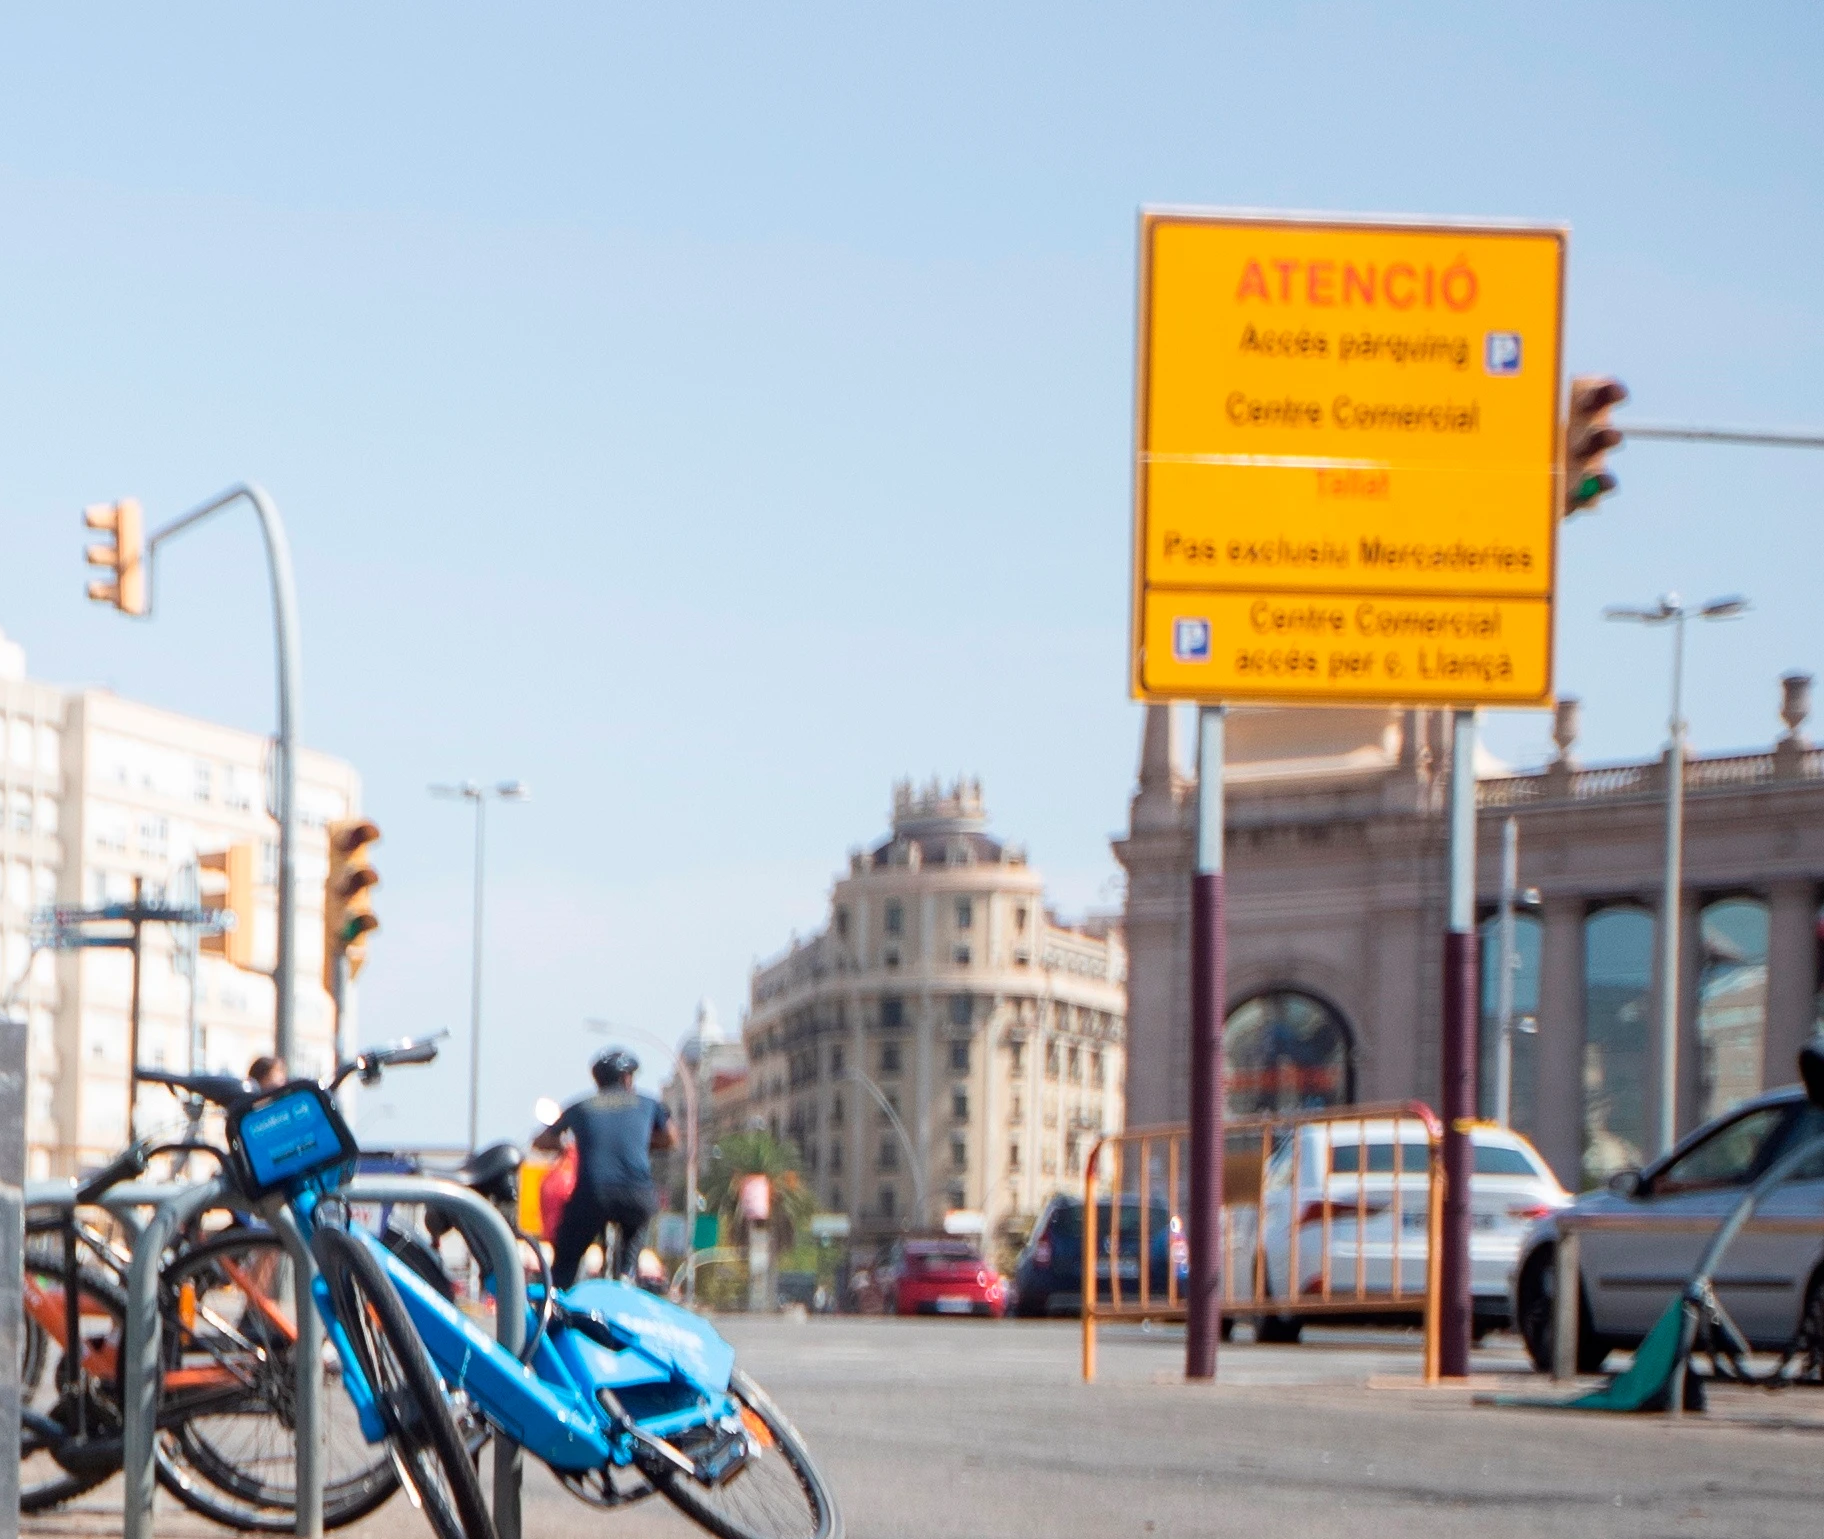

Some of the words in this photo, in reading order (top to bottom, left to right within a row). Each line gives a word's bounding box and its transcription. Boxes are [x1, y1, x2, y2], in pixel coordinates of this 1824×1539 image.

[1235, 252, 1479, 314] ATENCIÓ
[1225, 391, 1322, 428] Centre
[1331, 395, 1480, 433] Comercial
[1163, 530, 1217, 564] Pas
[1227, 534, 1348, 569] exclusiu
[1358, 534, 1533, 573] Mercaderies
[1250, 600, 1346, 636] Centre
[1355, 602, 1503, 640] Comercial
[1328, 650, 1373, 682] per
